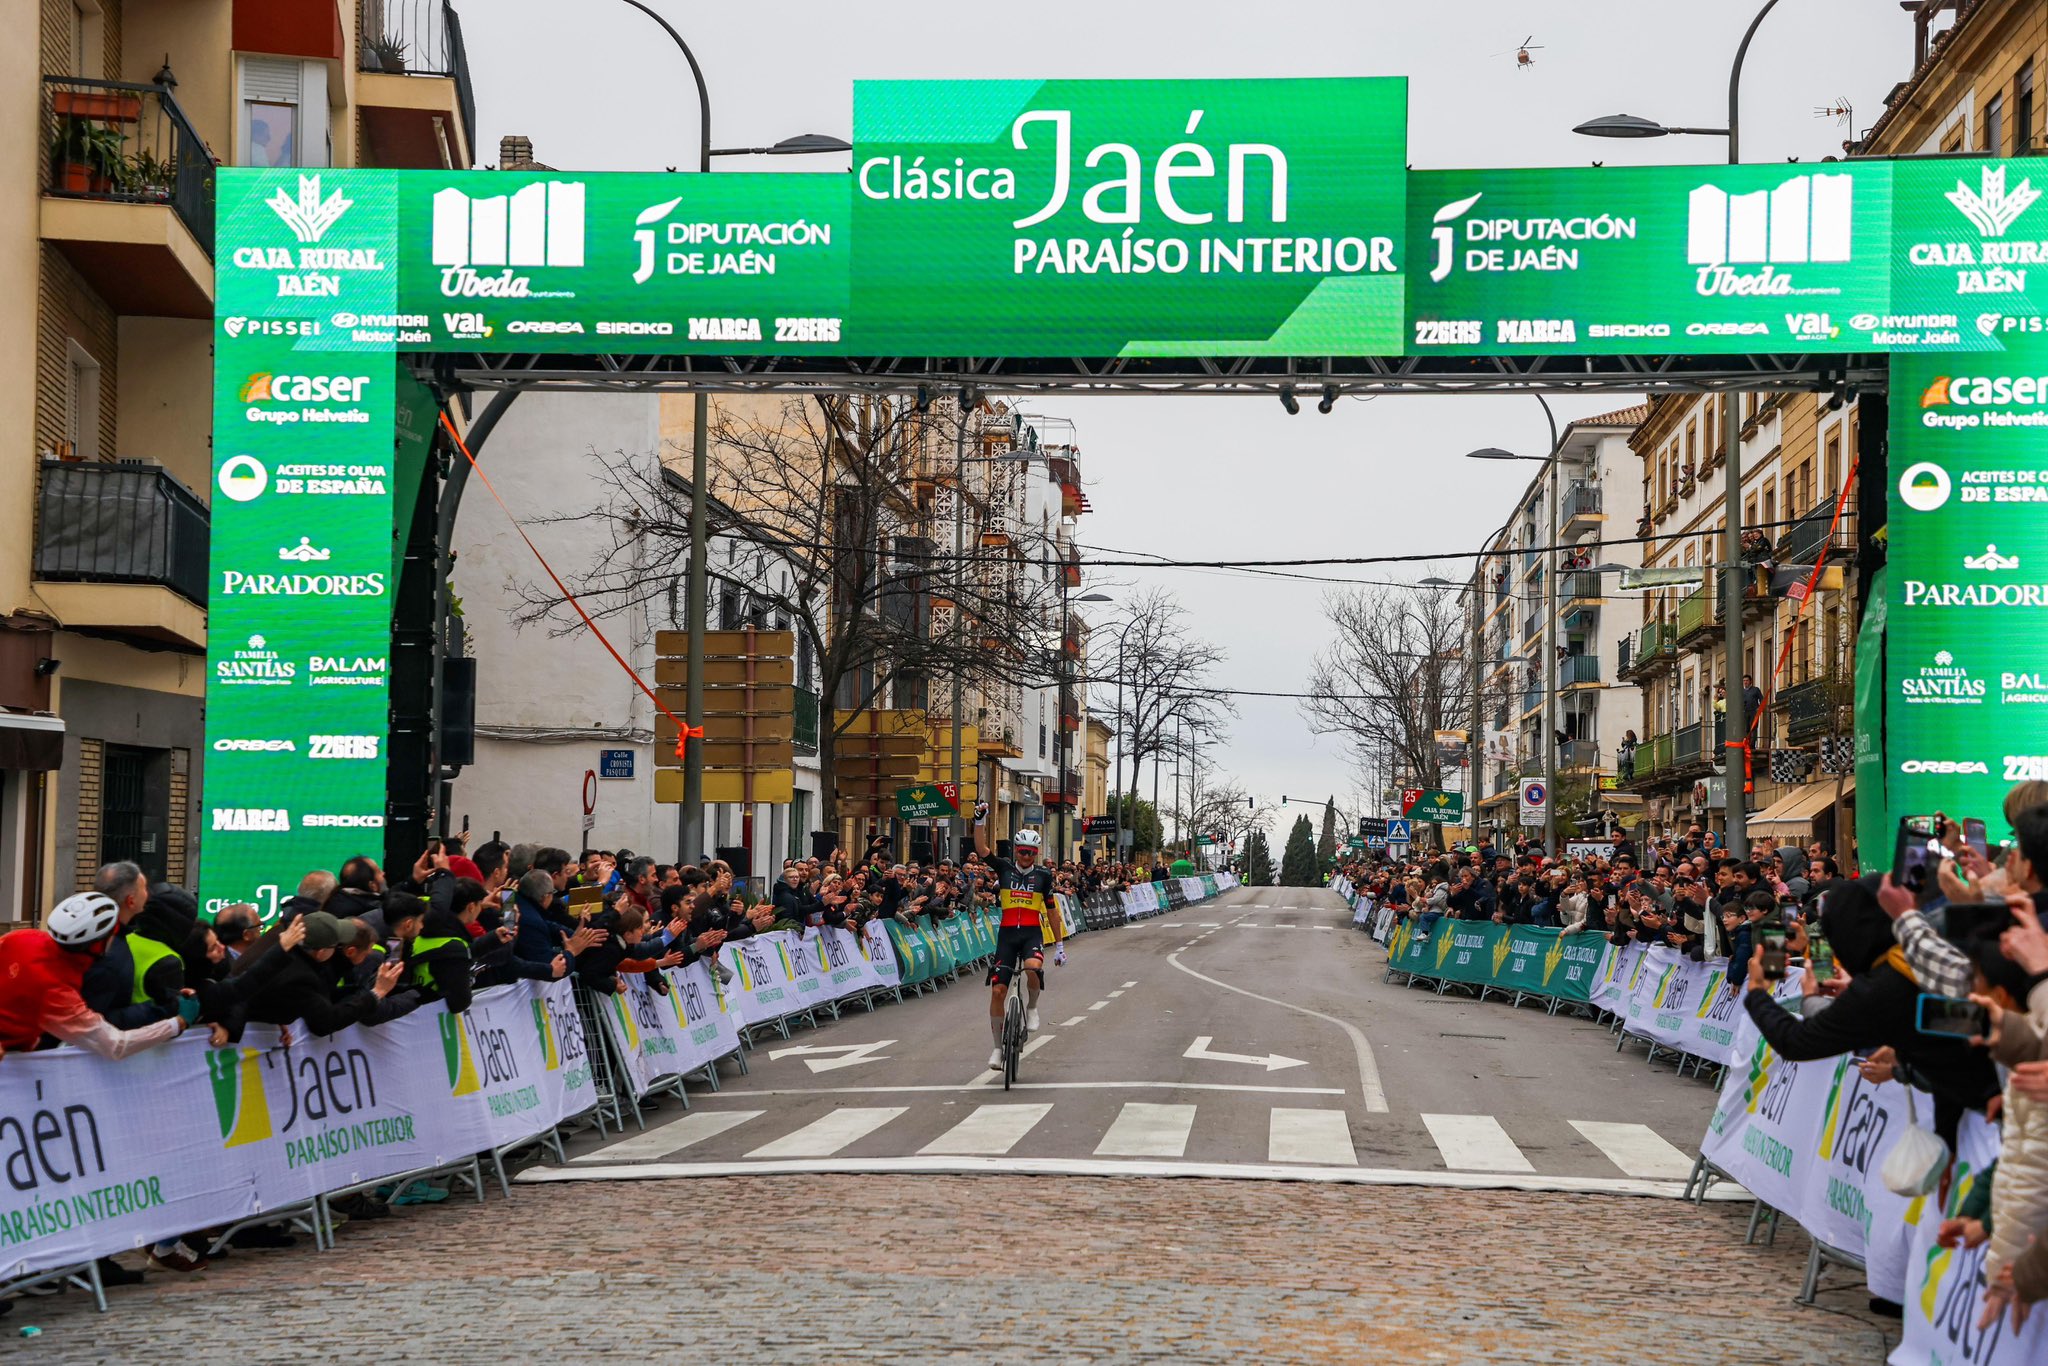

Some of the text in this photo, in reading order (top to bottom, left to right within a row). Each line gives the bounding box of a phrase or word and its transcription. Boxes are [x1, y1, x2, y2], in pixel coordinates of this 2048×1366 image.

[859, 110, 1288, 229] Clásica Jaén
[667, 219, 830, 245] DIPUTACIÓN
[1466, 213, 1636, 241] DIPUTACIÓN
[233, 248, 384, 270] CAJA RURAL
[1014, 226, 1397, 274] PARAÍSO INTERIOR
[1465, 246, 1578, 271] DE JAÉN
[1909, 242, 1976, 266] CAJA
[667, 249, 775, 274] DE JAÉN
[277, 272, 340, 297] JAÉN
[440, 265, 530, 298] Úbeda
[1696, 262, 1791, 297] Úbeda
[1956, 267, 2026, 294] JAÉN
[247, 321, 320, 336] PISSEI
[360, 314, 429, 327] HYUNDAI
[506, 321, 585, 334] ORBEA
[595, 321, 673, 335] SIROKO
[687, 317, 762, 341] MARCA
[774, 317, 842, 342] 226ERS
[1684, 322, 1770, 335] ORBEA
[1881, 314, 1957, 328] HYUNDAI
[2002, 316, 2048, 332] PIS
[352, 330, 431, 343] Motor Jaén
[1415, 320, 1483, 345] 226ERS
[1497, 319, 1576, 343] MARCA
[1588, 323, 1671, 337] SIROKO
[1872, 330, 1960, 345] Motor Jaén
[271, 375, 370, 402] caser
[246, 407, 370, 425] Grupo Helvetia
[1922, 411, 1981, 431] Grupo
[276, 464, 387, 477] ACEITES DE OLIVA
[1961, 471, 2016, 484] ACEITES
[2017, 471, 2037, 484] DE
[275, 476, 387, 495] DE ESPAÑA
[1960, 486, 1991, 502] DE
[222, 571, 385, 595] PARADORES
[234, 651, 279, 660] FAMILIA
[309, 656, 386, 672] BALAM
[217, 659, 296, 678] SANTÍAS
[1920, 667, 1968, 677] FAMILIA
[1902, 676, 1987, 696] SANTÍAS
[2001, 672, 2048, 690] BAL
[213, 739, 297, 752] ORBEA
[308, 734, 380, 760] 226ERS
[613, 751, 629, 759] Calle
[1901, 760, 1989, 774] ORBEA
[943, 785, 956, 798] 25
[1404, 790, 1417, 803] 25
[901, 802, 940, 812] CAJA RURAL
[1422, 806, 1461, 816] CAJA RURAL
[211, 808, 291, 832] MARCA
[302, 814, 385, 828] SIROKO
[1010, 881, 1035, 892] UAE
[1454, 933, 1485, 949] CAJA RURAL
[1511, 939, 1523, 953] CAJA
[1456, 950, 1473, 965] JAÉN
[1563, 945, 1598, 965] CAJA RURAL
[1511, 957, 1527, 973] JAÉN
[1564, 963, 1584, 981] JAÉN
[285, 1115, 416, 1169] PARAÍSO INTERIOR
[71, 1175, 166, 1226] INTERIOR
